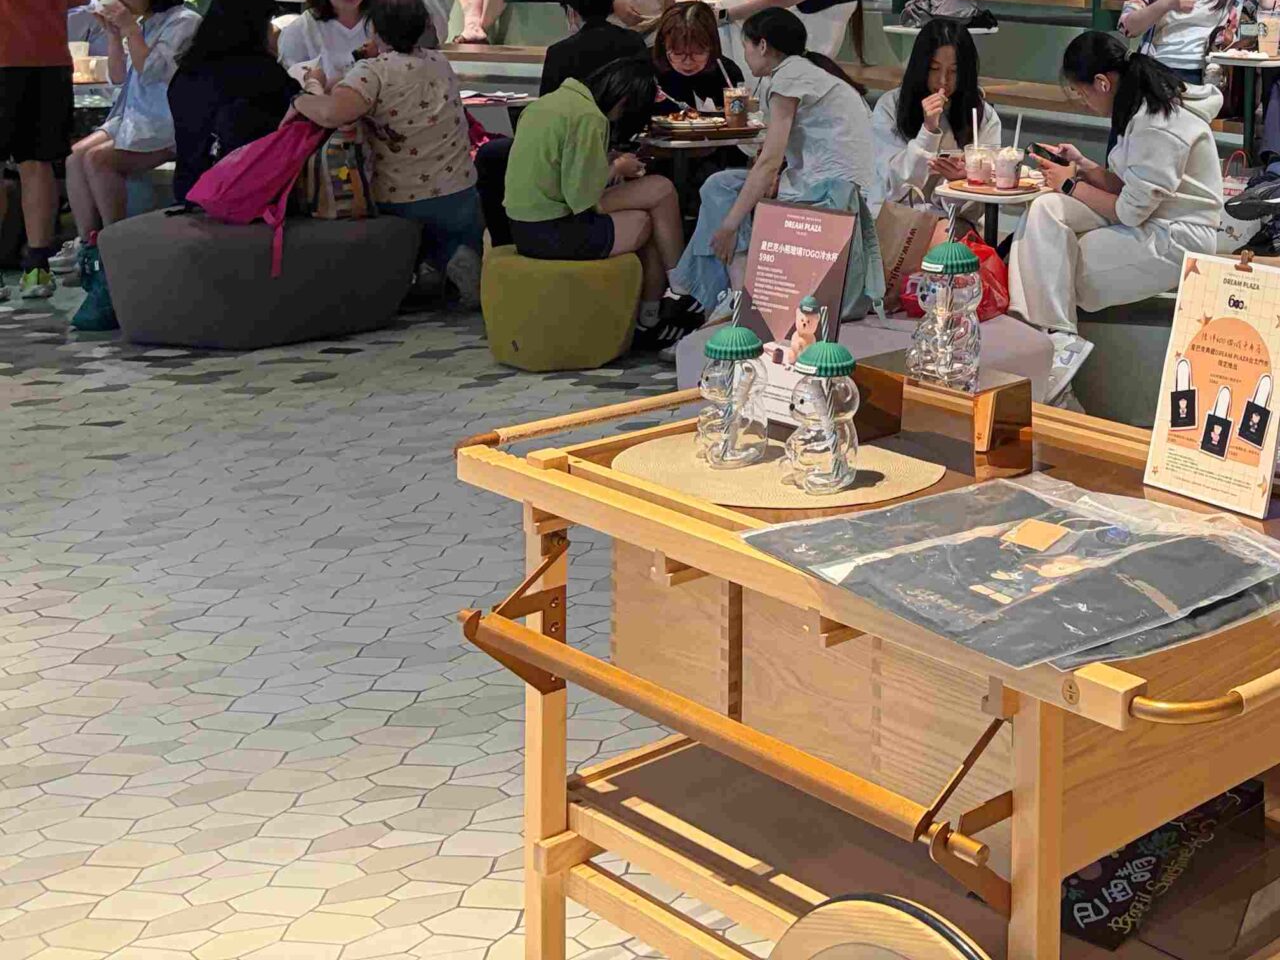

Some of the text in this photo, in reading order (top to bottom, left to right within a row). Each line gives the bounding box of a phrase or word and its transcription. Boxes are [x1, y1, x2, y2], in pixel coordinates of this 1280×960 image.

[784, 219, 822, 233] DREAM PLAZA
[759, 252, 775, 264] $980
[1223, 278, 1260, 290] DREAM PLAZA
